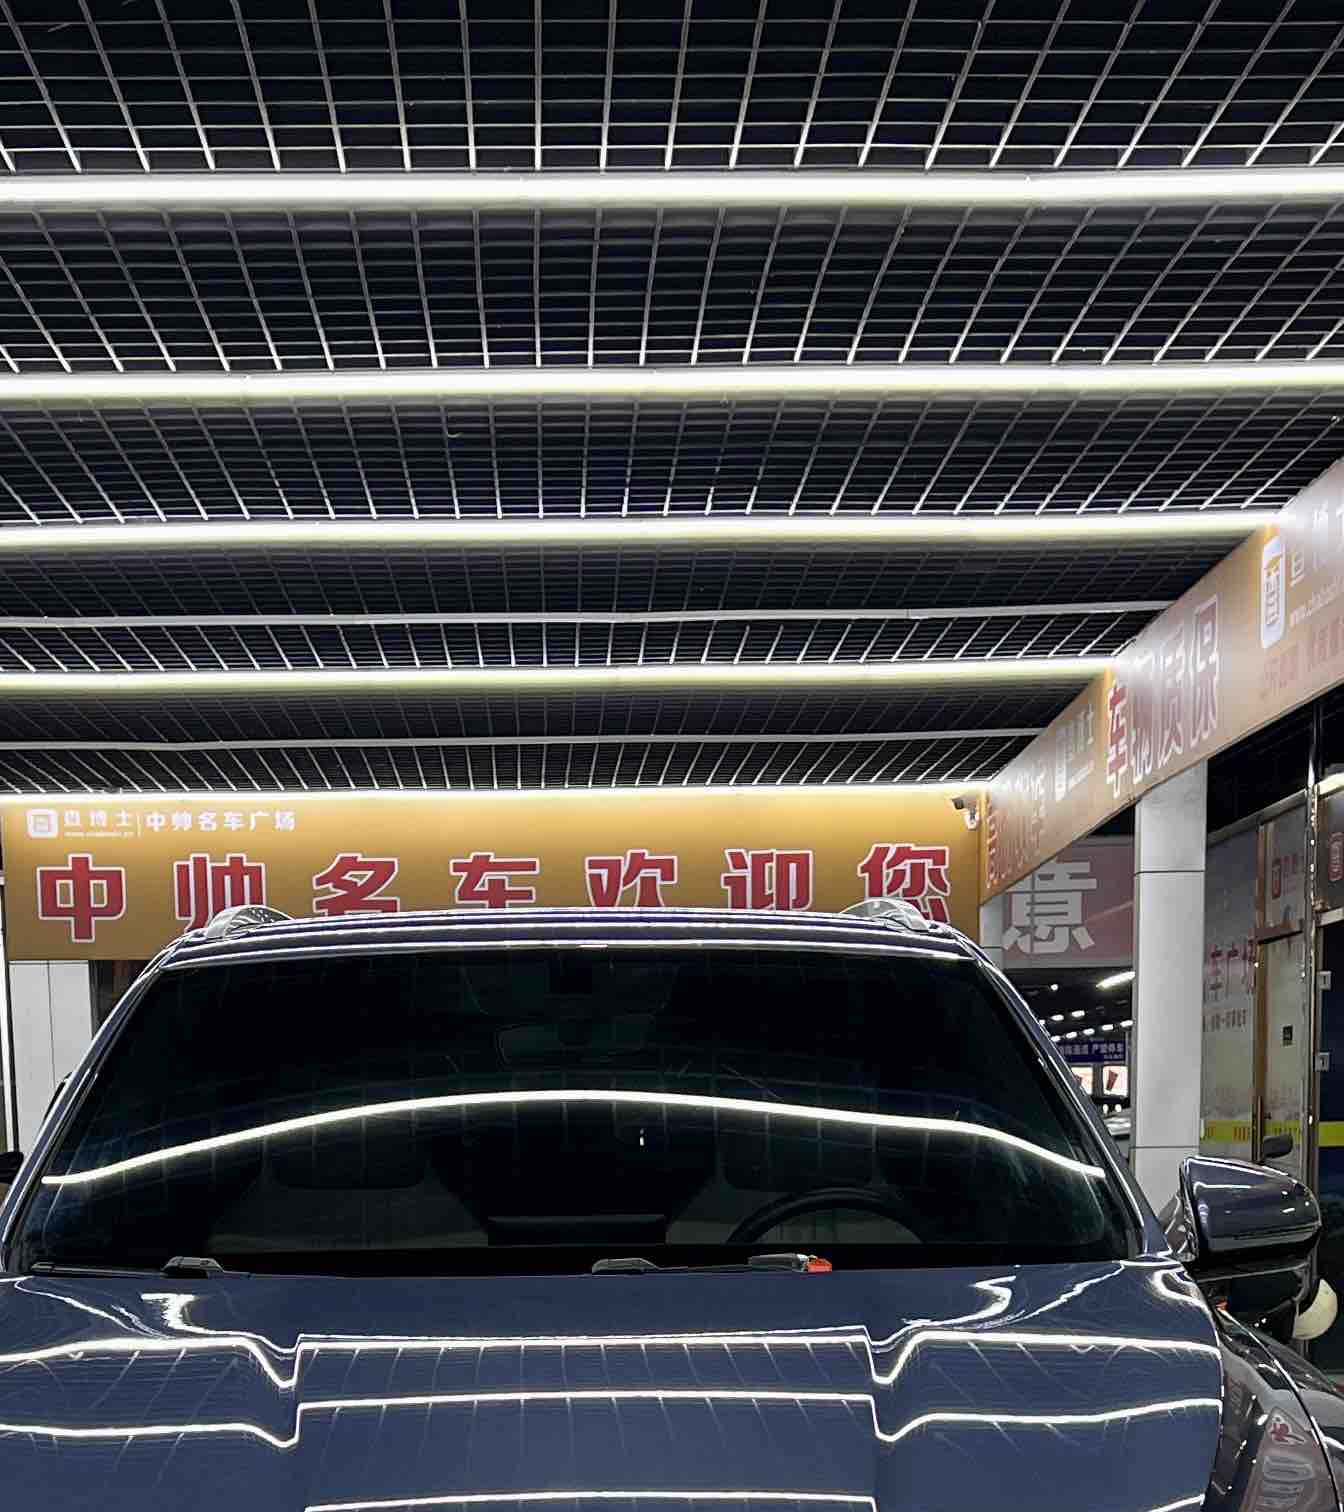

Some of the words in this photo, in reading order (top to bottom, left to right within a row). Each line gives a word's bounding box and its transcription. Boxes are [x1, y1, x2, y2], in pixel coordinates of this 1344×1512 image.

[37, 843, 951, 943] 中帅名车欢迎您
